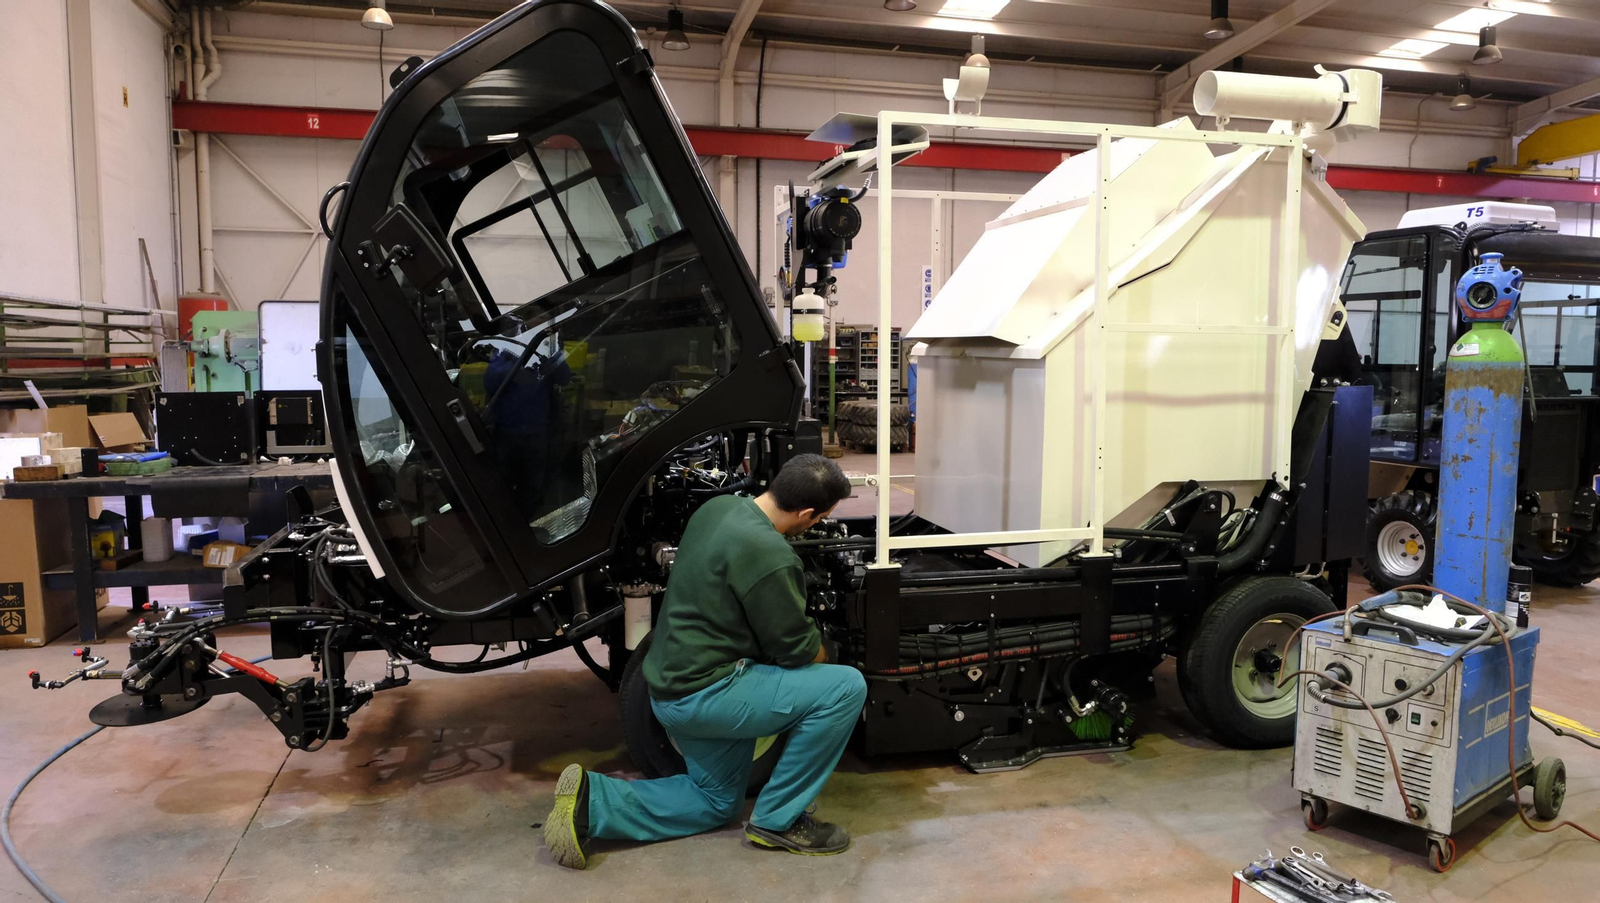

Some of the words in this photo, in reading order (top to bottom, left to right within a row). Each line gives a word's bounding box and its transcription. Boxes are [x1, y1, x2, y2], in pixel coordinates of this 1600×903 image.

[308, 117, 320, 129] 12
[1437, 179, 1443, 188] 7
[1466, 206, 1485, 218] T5
